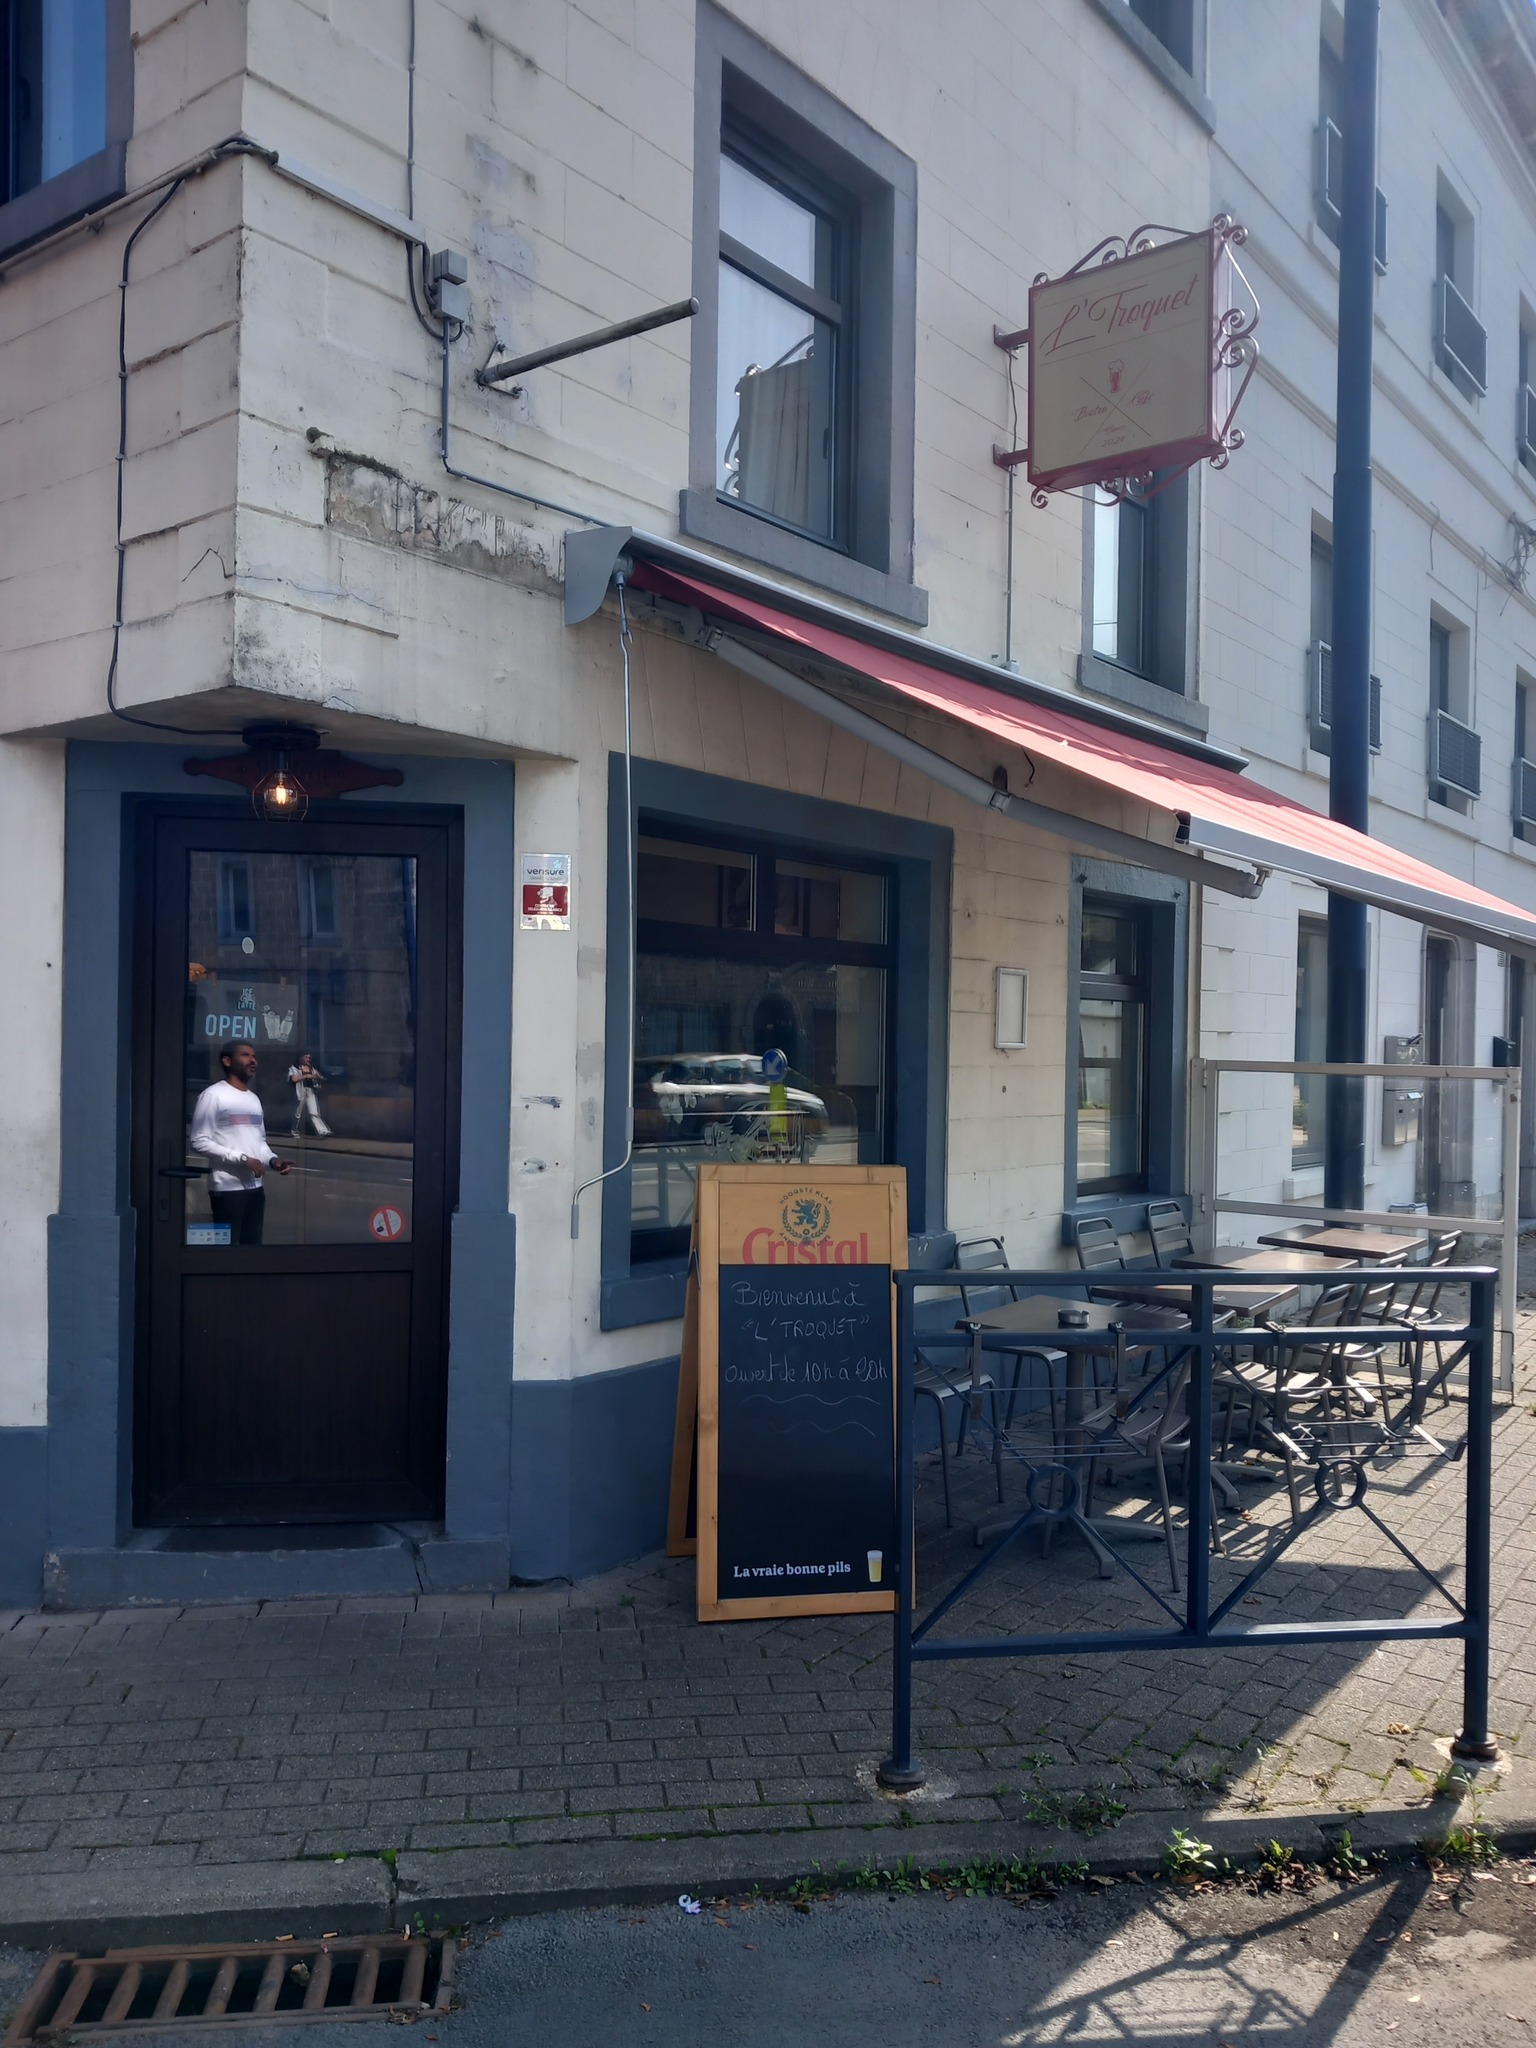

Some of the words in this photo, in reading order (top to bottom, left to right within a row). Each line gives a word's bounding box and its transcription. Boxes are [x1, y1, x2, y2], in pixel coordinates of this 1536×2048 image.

[1039, 272, 1200, 357] L'Troquet
[526, 868, 565, 876] verisure
[204, 1013, 257, 1039] OPEN
[742, 1227, 868, 1265] Cristal
[733, 1565, 750, 1578] La
[752, 1563, 784, 1577] vraie
[786, 1562, 826, 1576] bonne
[828, 1560, 852, 1577] pils
